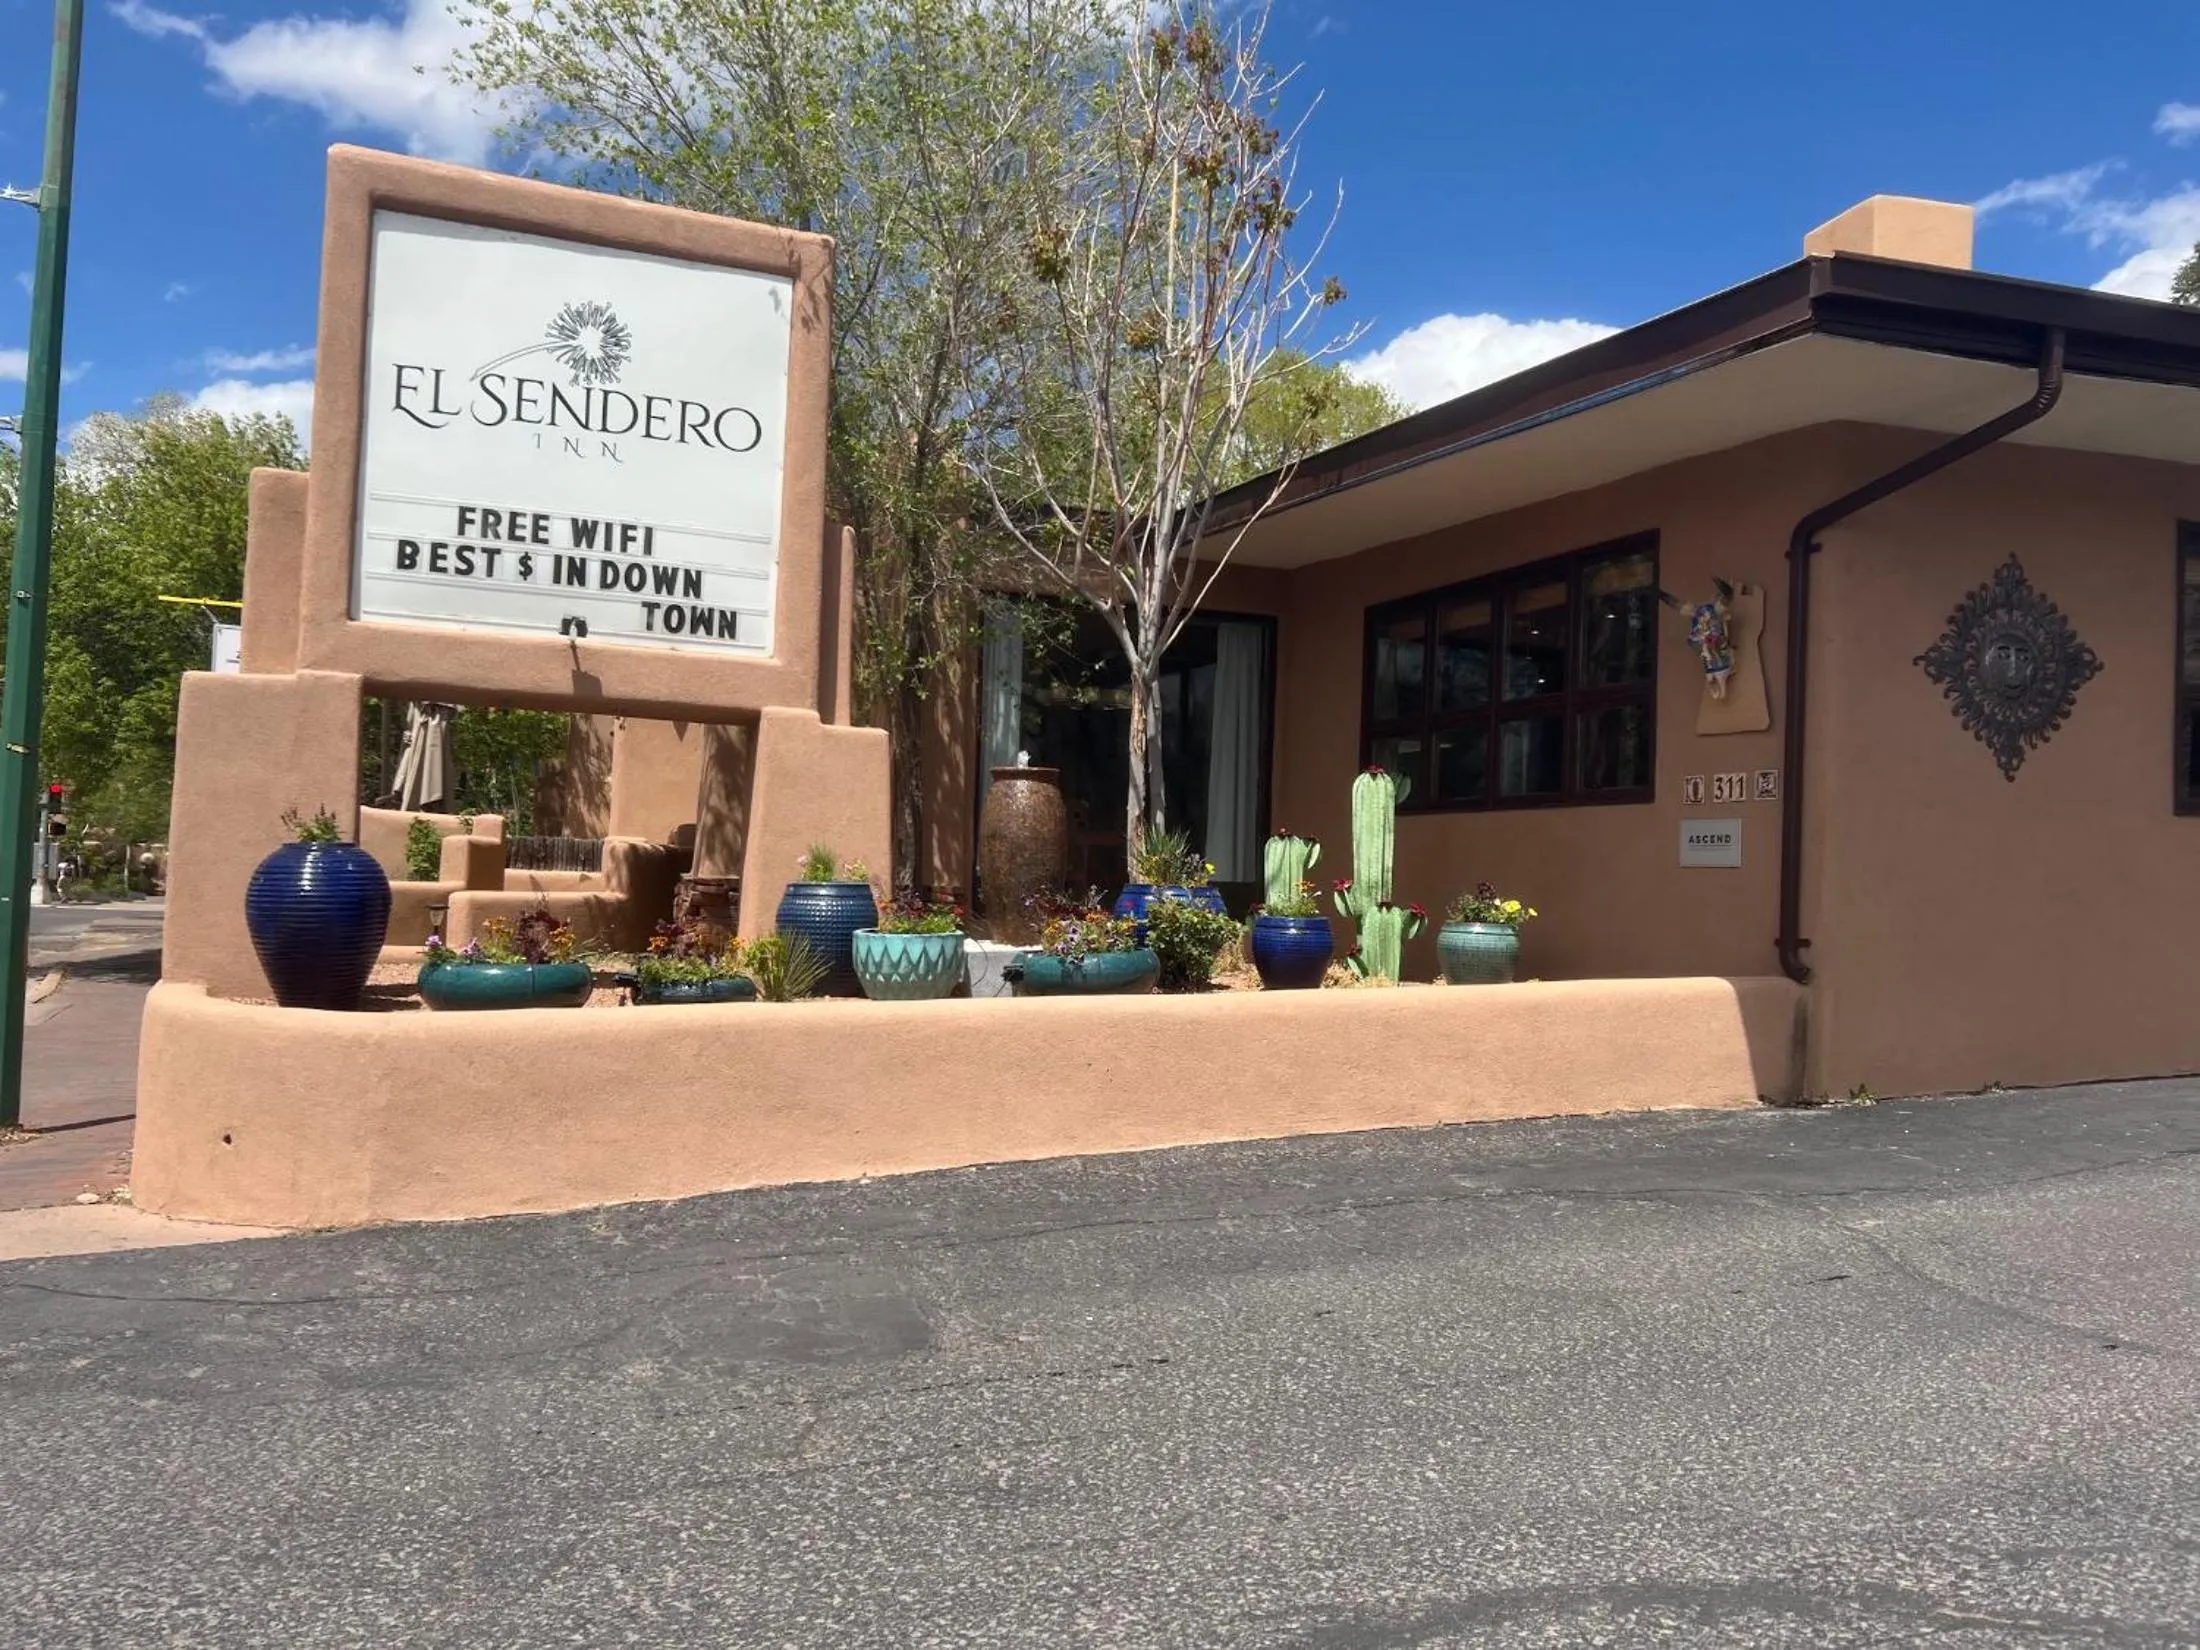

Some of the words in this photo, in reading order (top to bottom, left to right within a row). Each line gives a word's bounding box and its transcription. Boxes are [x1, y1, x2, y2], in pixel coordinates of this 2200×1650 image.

[392, 363, 462, 429] EL
[470, 372, 762, 453] SENDERO
[534, 433, 623, 463] INN
[457, 505, 550, 545] FREE
[571, 516, 654, 557] WIFI
[397, 538, 502, 578] BEST
[517, 552, 534, 581] $
[600, 561, 702, 600] DOWN
[641, 601, 738, 640] TOWN
[1715, 776, 1744, 800] 311
[1688, 834, 1732, 844] ASCEND
